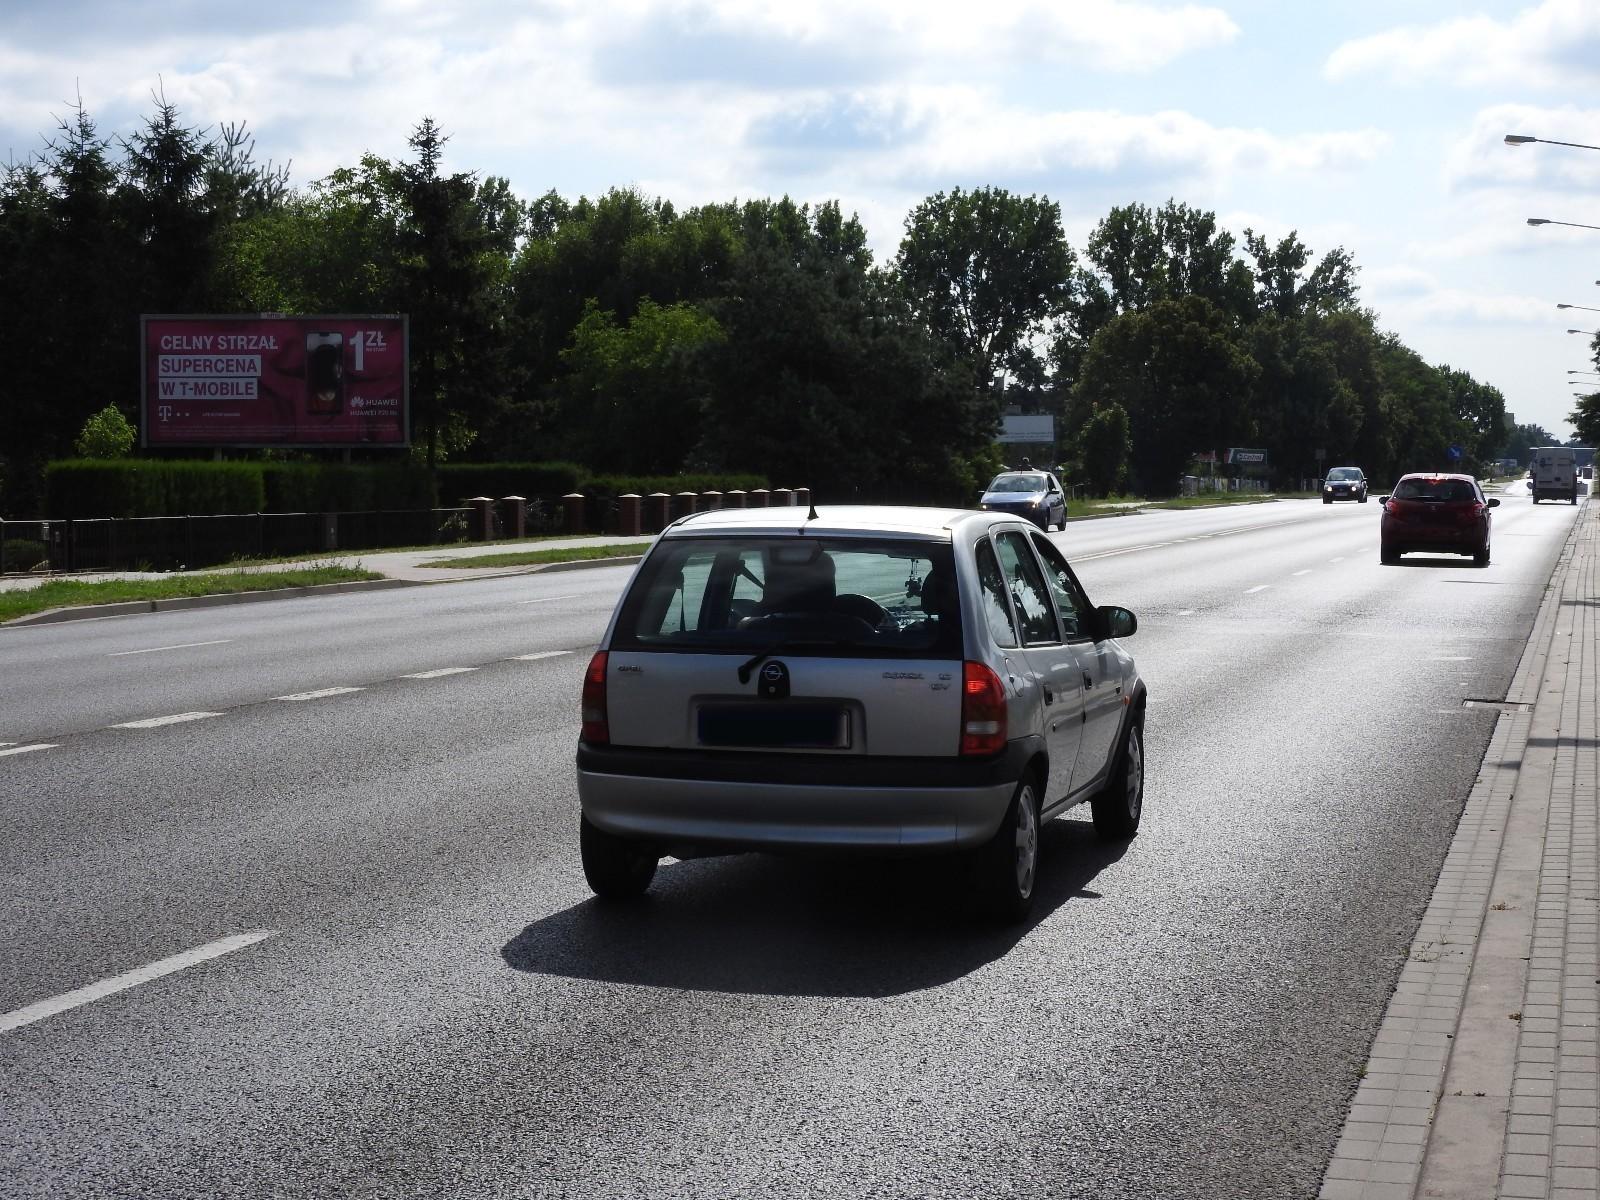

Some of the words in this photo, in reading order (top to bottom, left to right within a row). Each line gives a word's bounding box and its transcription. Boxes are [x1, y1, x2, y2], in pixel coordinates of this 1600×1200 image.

[160, 335, 214, 350] CELNY
[216, 335, 279, 350] STRZAŁ
[349, 330, 365, 371] 1
[365, 331, 387, 346] ZŁ
[160, 358, 258, 373] SUPERCENA
[160, 381, 176, 396] W
[179, 381, 254, 396] T-MOBILE
